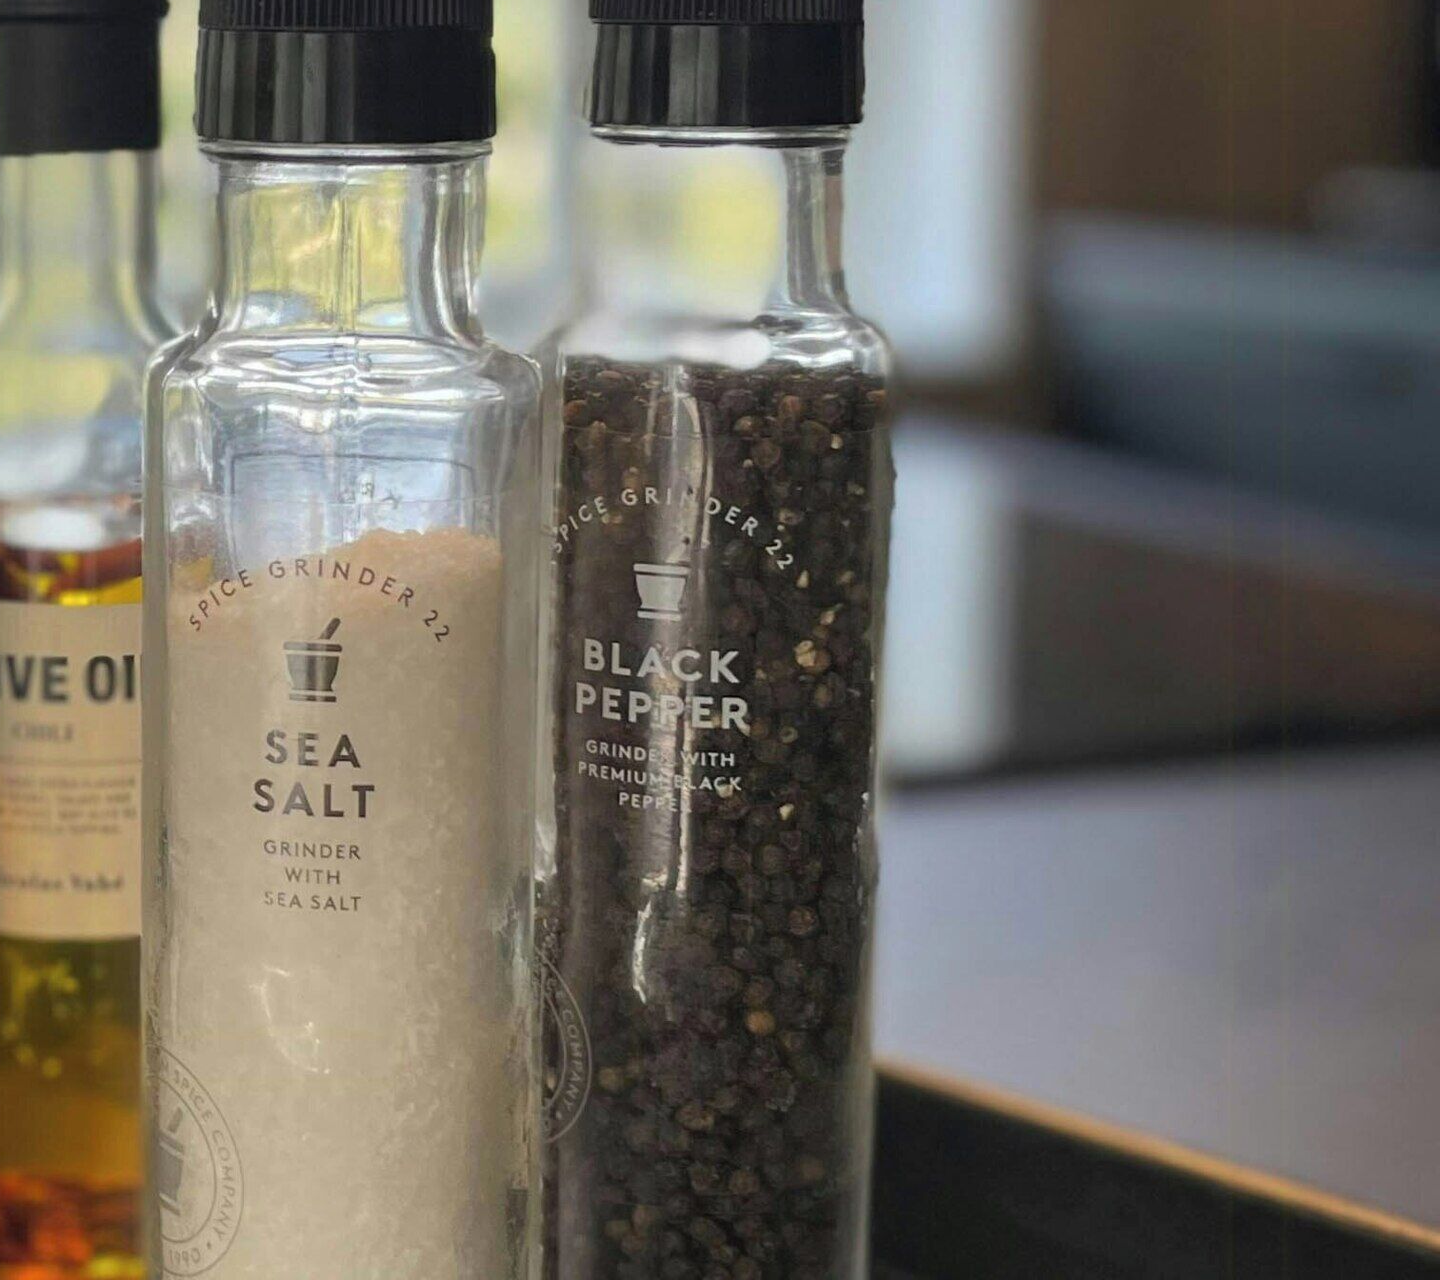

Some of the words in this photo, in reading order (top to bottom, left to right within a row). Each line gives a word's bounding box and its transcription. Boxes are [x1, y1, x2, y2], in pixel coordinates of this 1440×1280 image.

[621, 488, 759, 537] GRINDER
[765, 538, 795, 571] 22
[188, 567, 253, 632] SPICE
[268, 557, 415, 609] GRINDER
[422, 609, 452, 644] 22
[86, 654, 137, 704] OI
[583, 638, 741, 683] BLACK
[575, 682, 751, 735] PEPPER
[264, 729, 361, 769] SEA
[680, 750, 736, 767] WITH
[578, 761, 666, 787] PREMIUM
[674, 774, 743, 792] BLACK
[253, 780, 376, 819] SALT
[263, 839, 362, 861] GRINDER
[284, 867, 341, 886] WITH
[264, 891, 303, 909] SEA
[311, 895, 362, 913] SALT
[562, 1007, 586, 1113] COMPANY
[173, 1069, 213, 1123] SPICE
[211, 1128, 236, 1242] COMPANY
